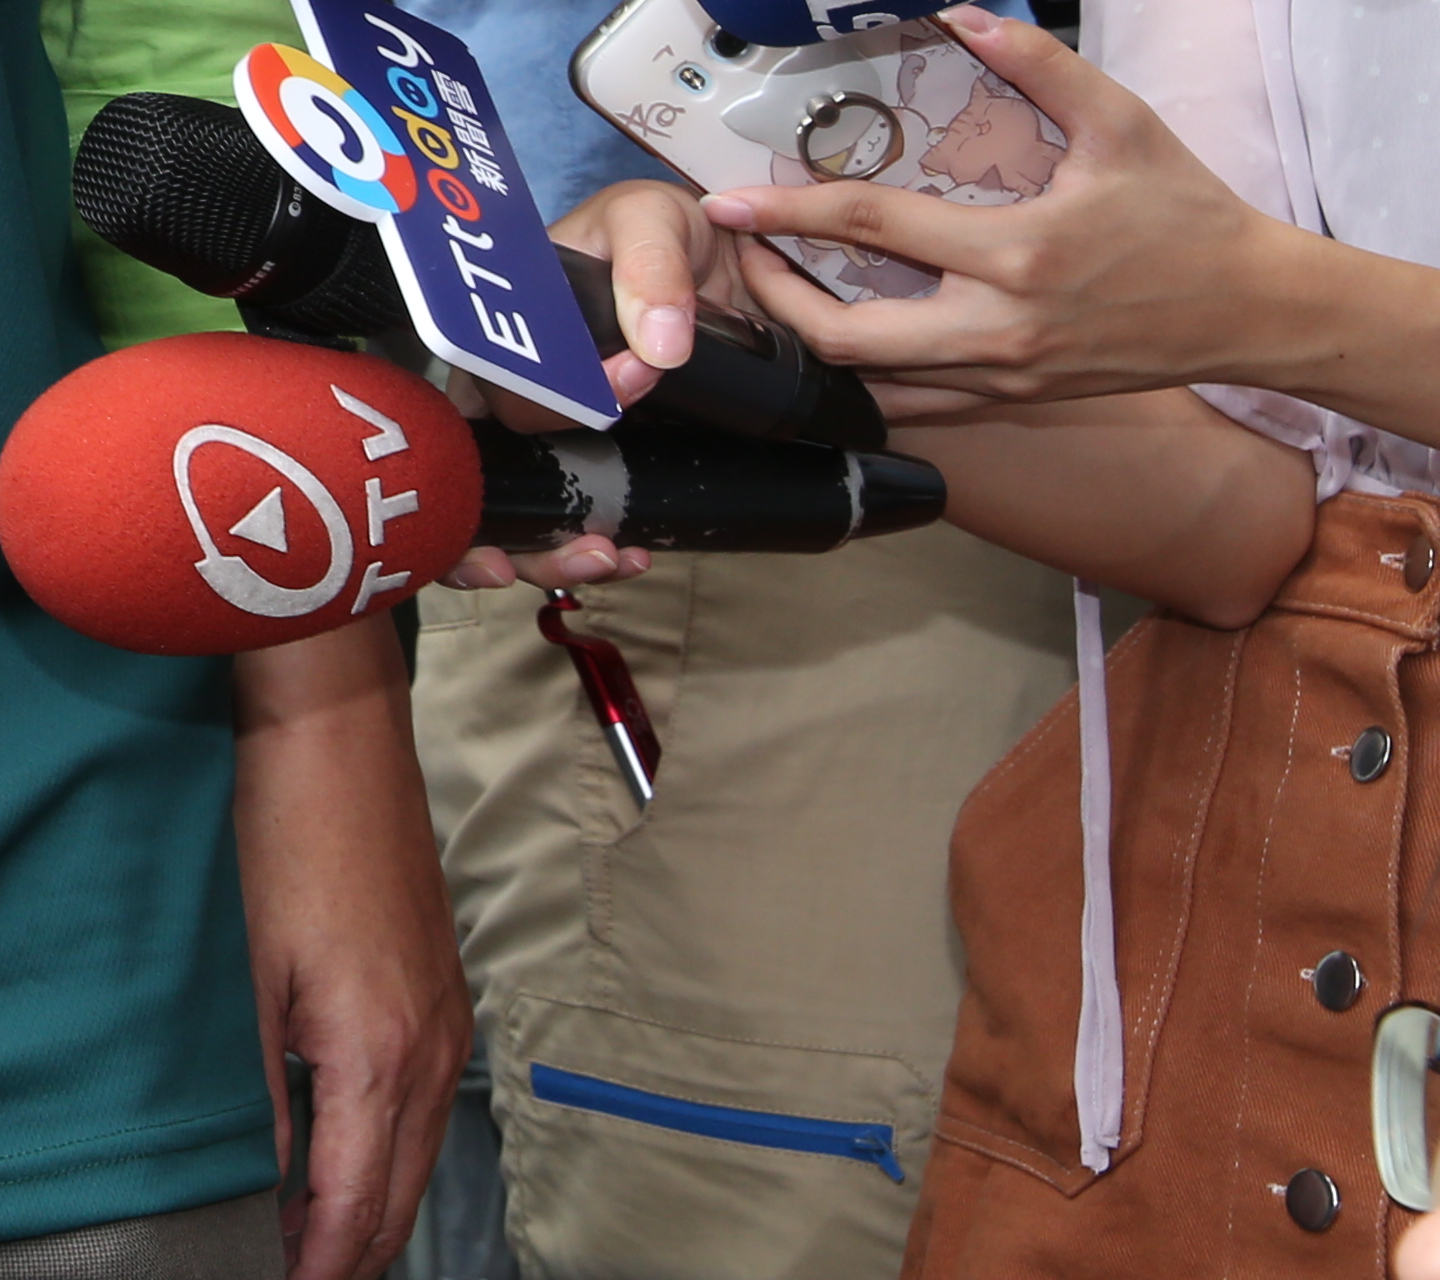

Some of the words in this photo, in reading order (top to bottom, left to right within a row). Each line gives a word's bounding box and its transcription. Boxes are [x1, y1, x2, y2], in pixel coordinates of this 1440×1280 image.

[364, 12, 541, 364] ETtoday
[431, 69, 509, 196] 新聞雲
[331, 384, 420, 615] TTV
